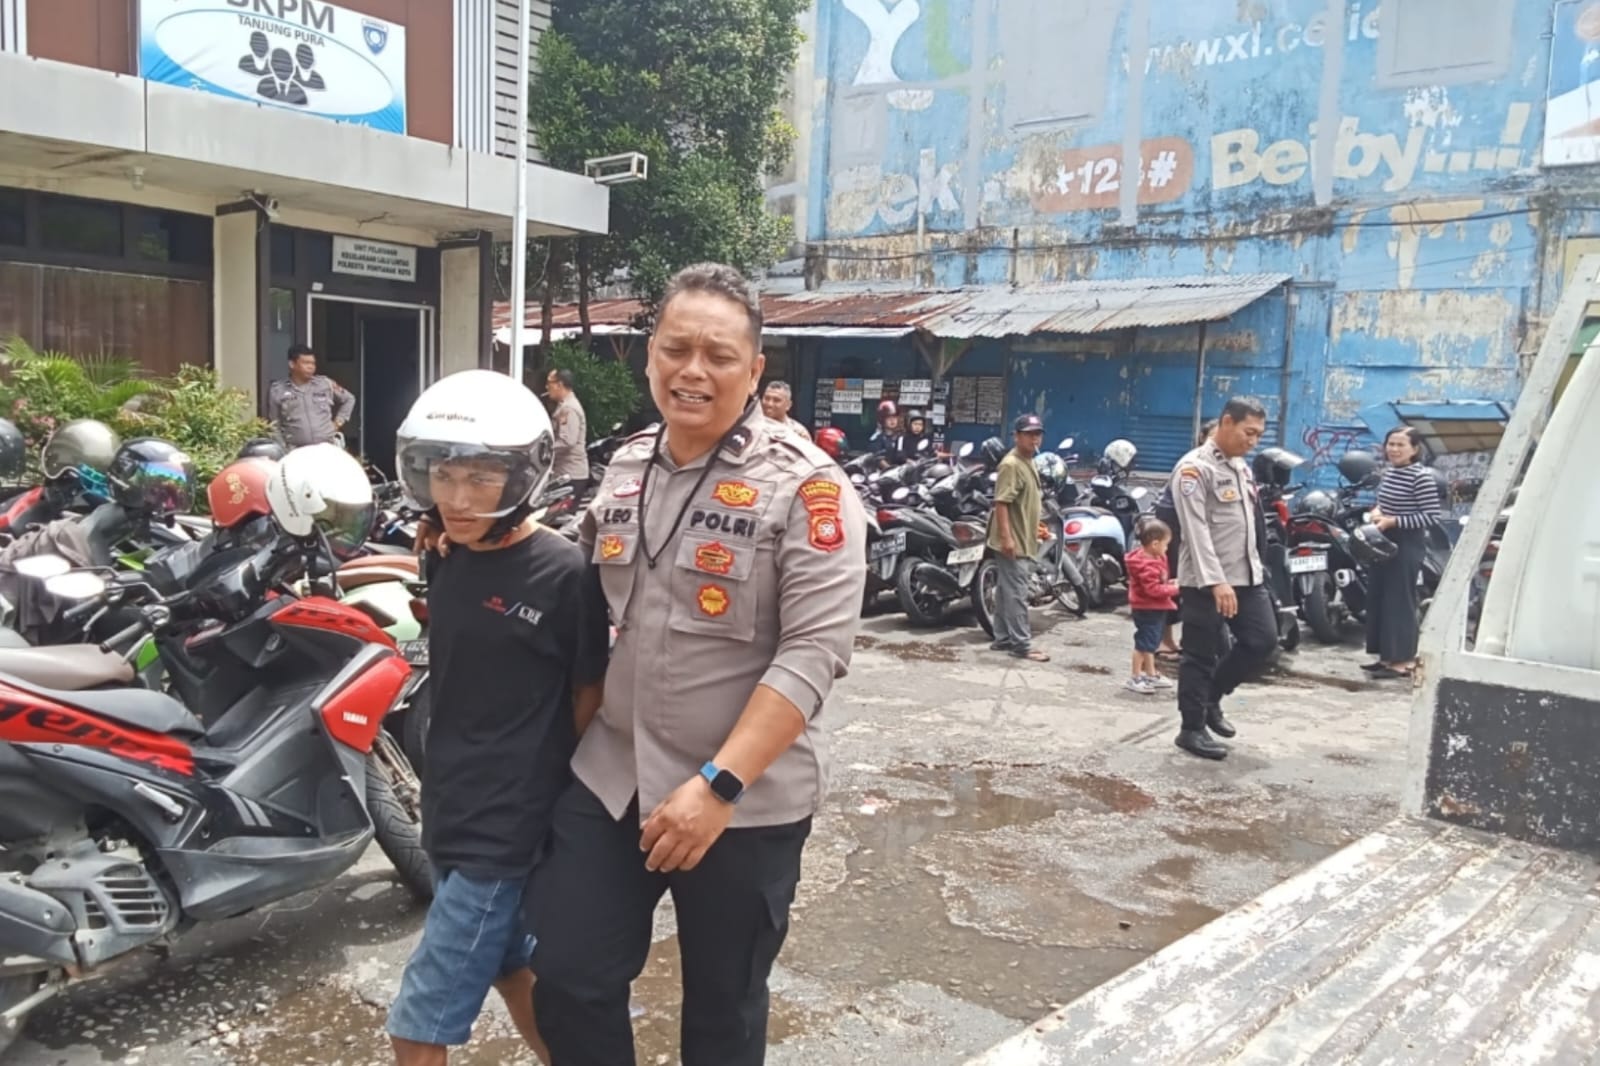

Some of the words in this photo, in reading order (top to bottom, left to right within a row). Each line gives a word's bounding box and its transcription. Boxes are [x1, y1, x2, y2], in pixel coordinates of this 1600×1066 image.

[237, 13, 292, 38] TANJUNG
[293, 29, 326, 48] PURA
[603, 507, 633, 524] LEO
[689, 509, 757, 538] POLRI
